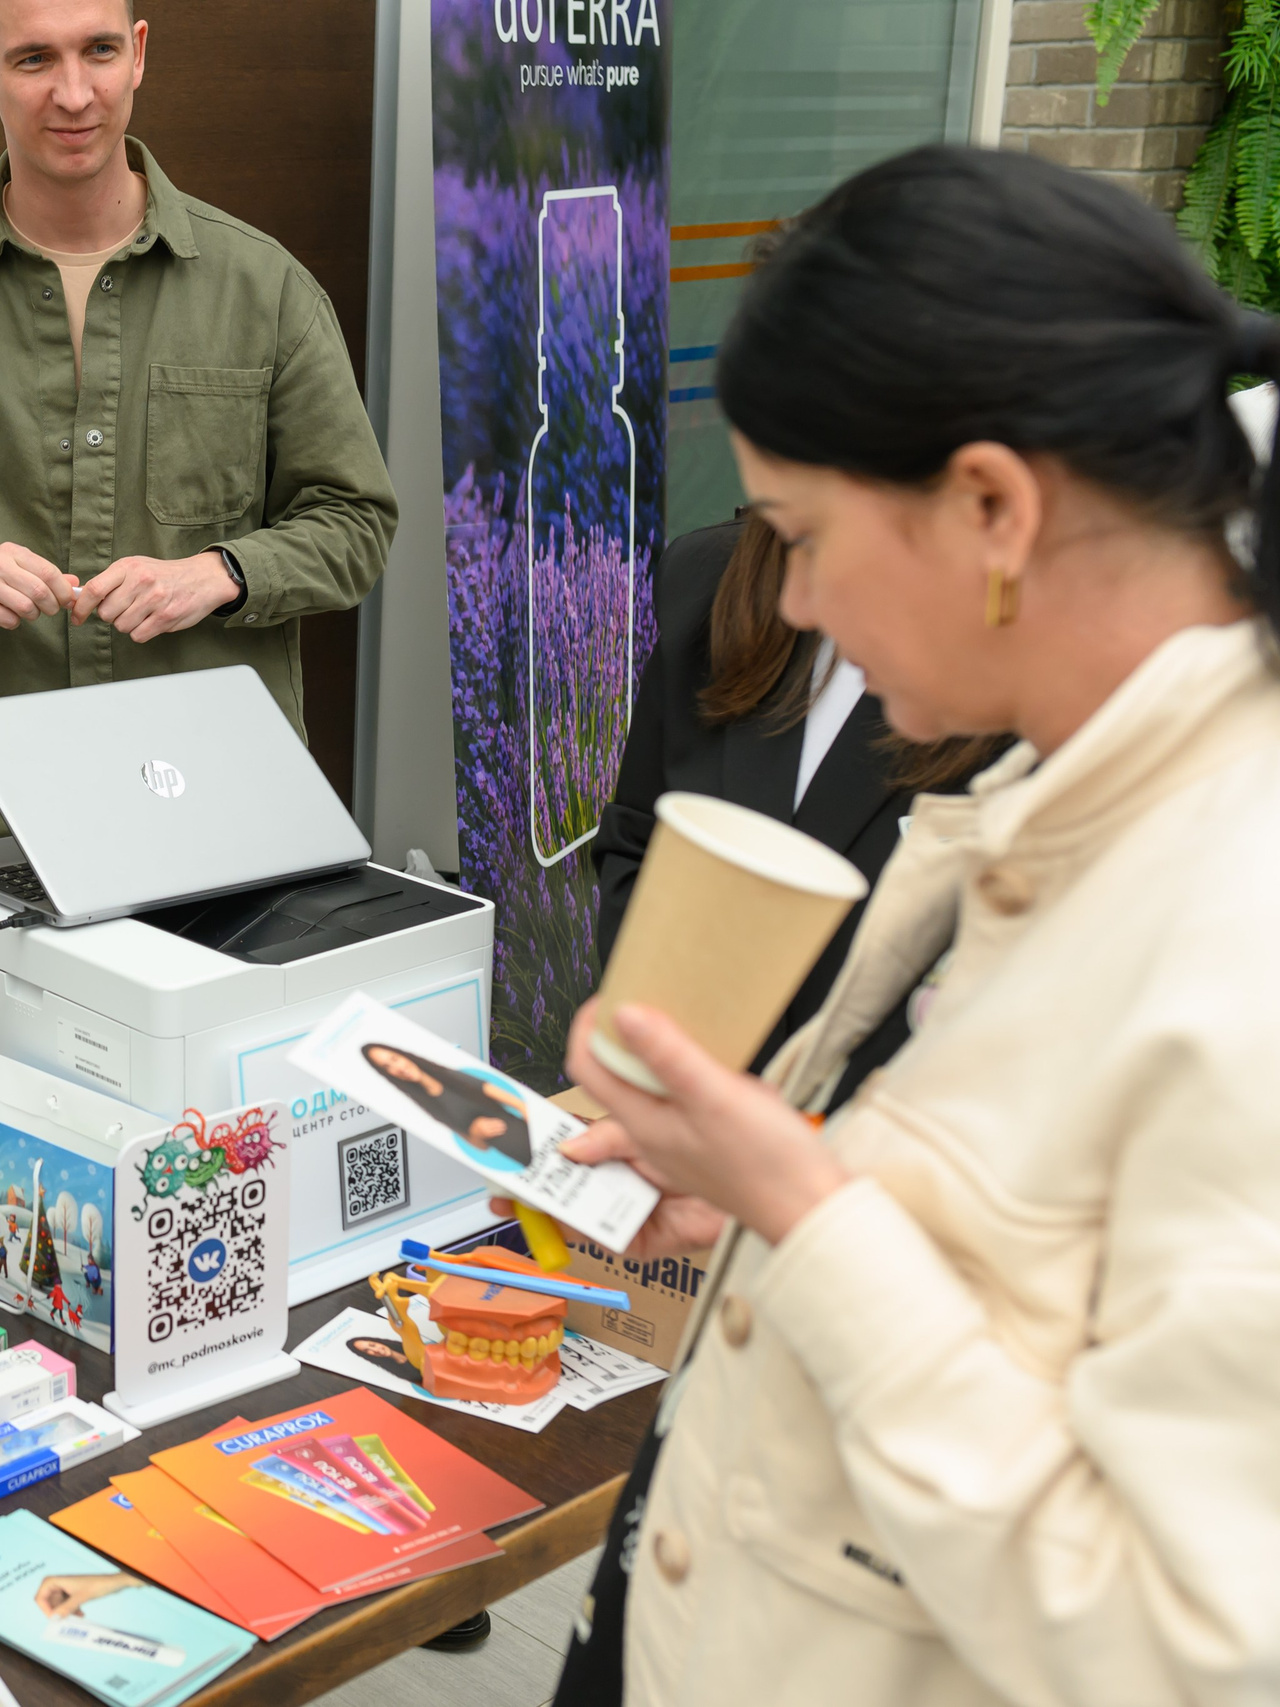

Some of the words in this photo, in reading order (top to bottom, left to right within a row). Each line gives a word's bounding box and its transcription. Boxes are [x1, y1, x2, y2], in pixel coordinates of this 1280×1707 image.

[520, 64, 564, 93] pursue
[566, 58, 605, 86] what's
[606, 65, 640, 93] pure
[292, 1115, 334, 1138] ЦЕНТР
[340, 1104, 370, 1121] СТО
[147, 1326, 264, 1376] @mc_podmoskovie
[220, 1412, 330, 1455] CURAPROX
[7, 1461, 59, 1492] CURAPROX
